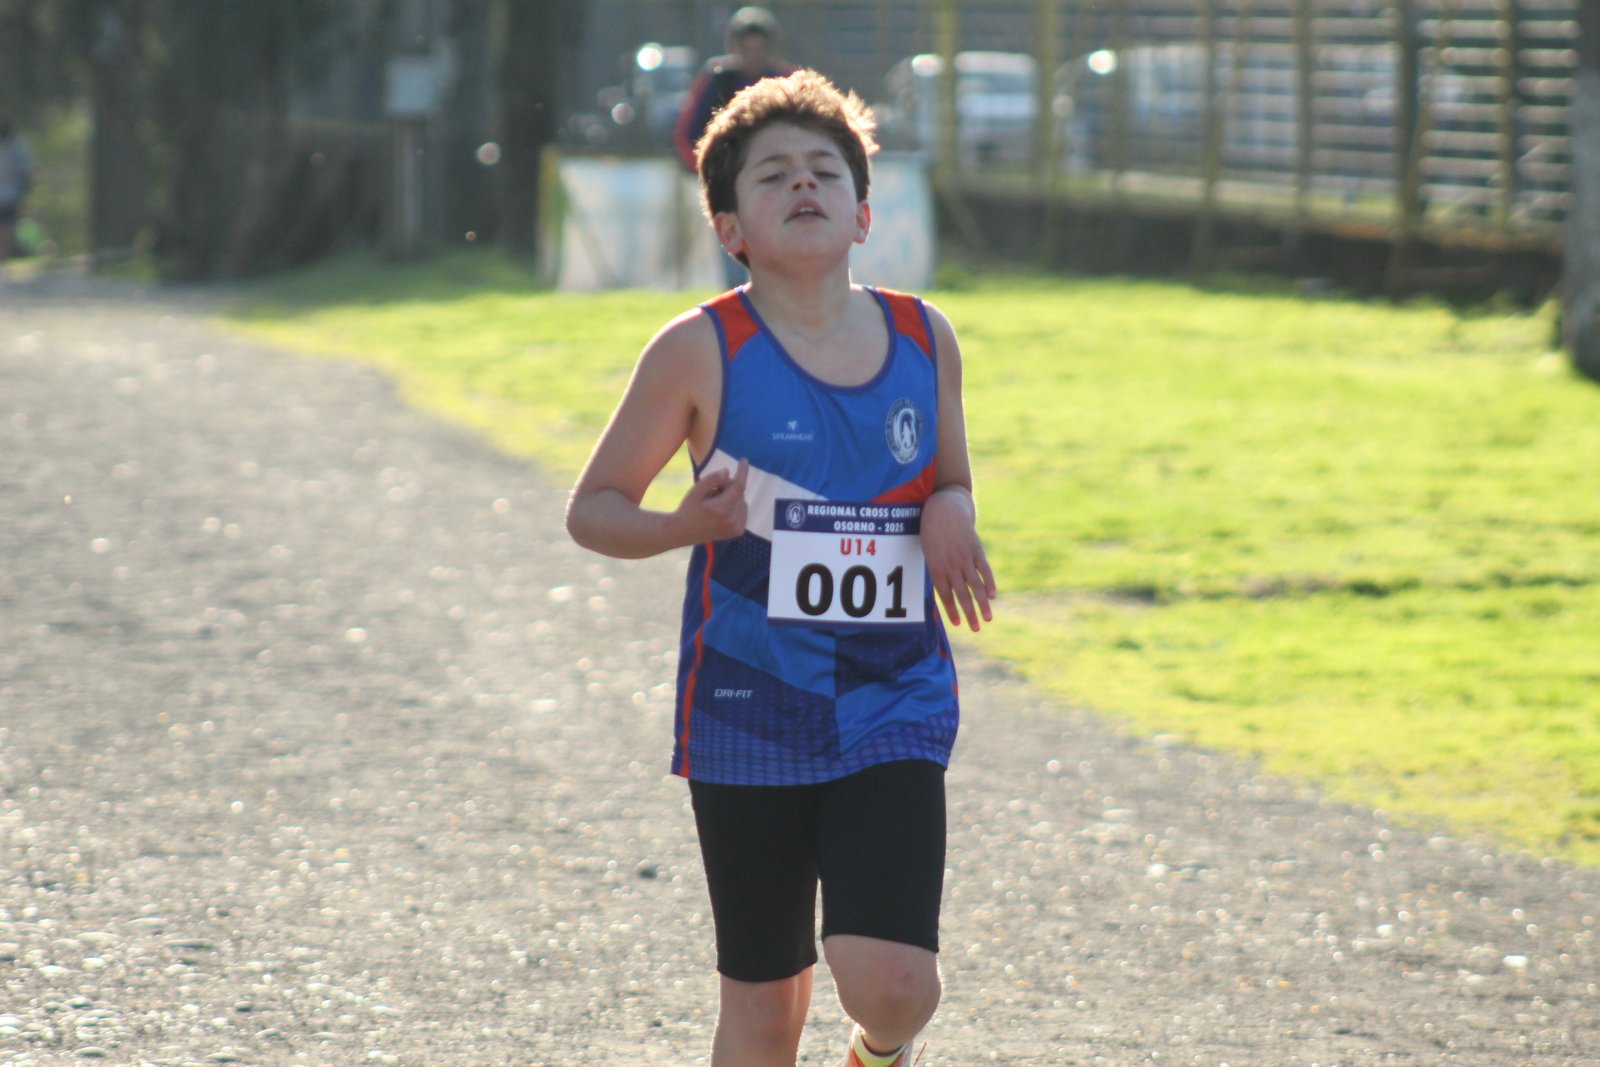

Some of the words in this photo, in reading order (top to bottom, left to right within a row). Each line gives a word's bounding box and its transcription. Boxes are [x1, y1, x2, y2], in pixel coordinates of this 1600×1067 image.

[772, 433, 814, 441] SPEARHEAD
[807, 505, 857, 517] REGIONAL
[859, 507, 889, 518] CROSS
[833, 521, 875, 532] OSORNO
[840, 538, 877, 556] U14
[795, 562, 908, 619] 001
[714, 688, 753, 698] DRI-FIT
